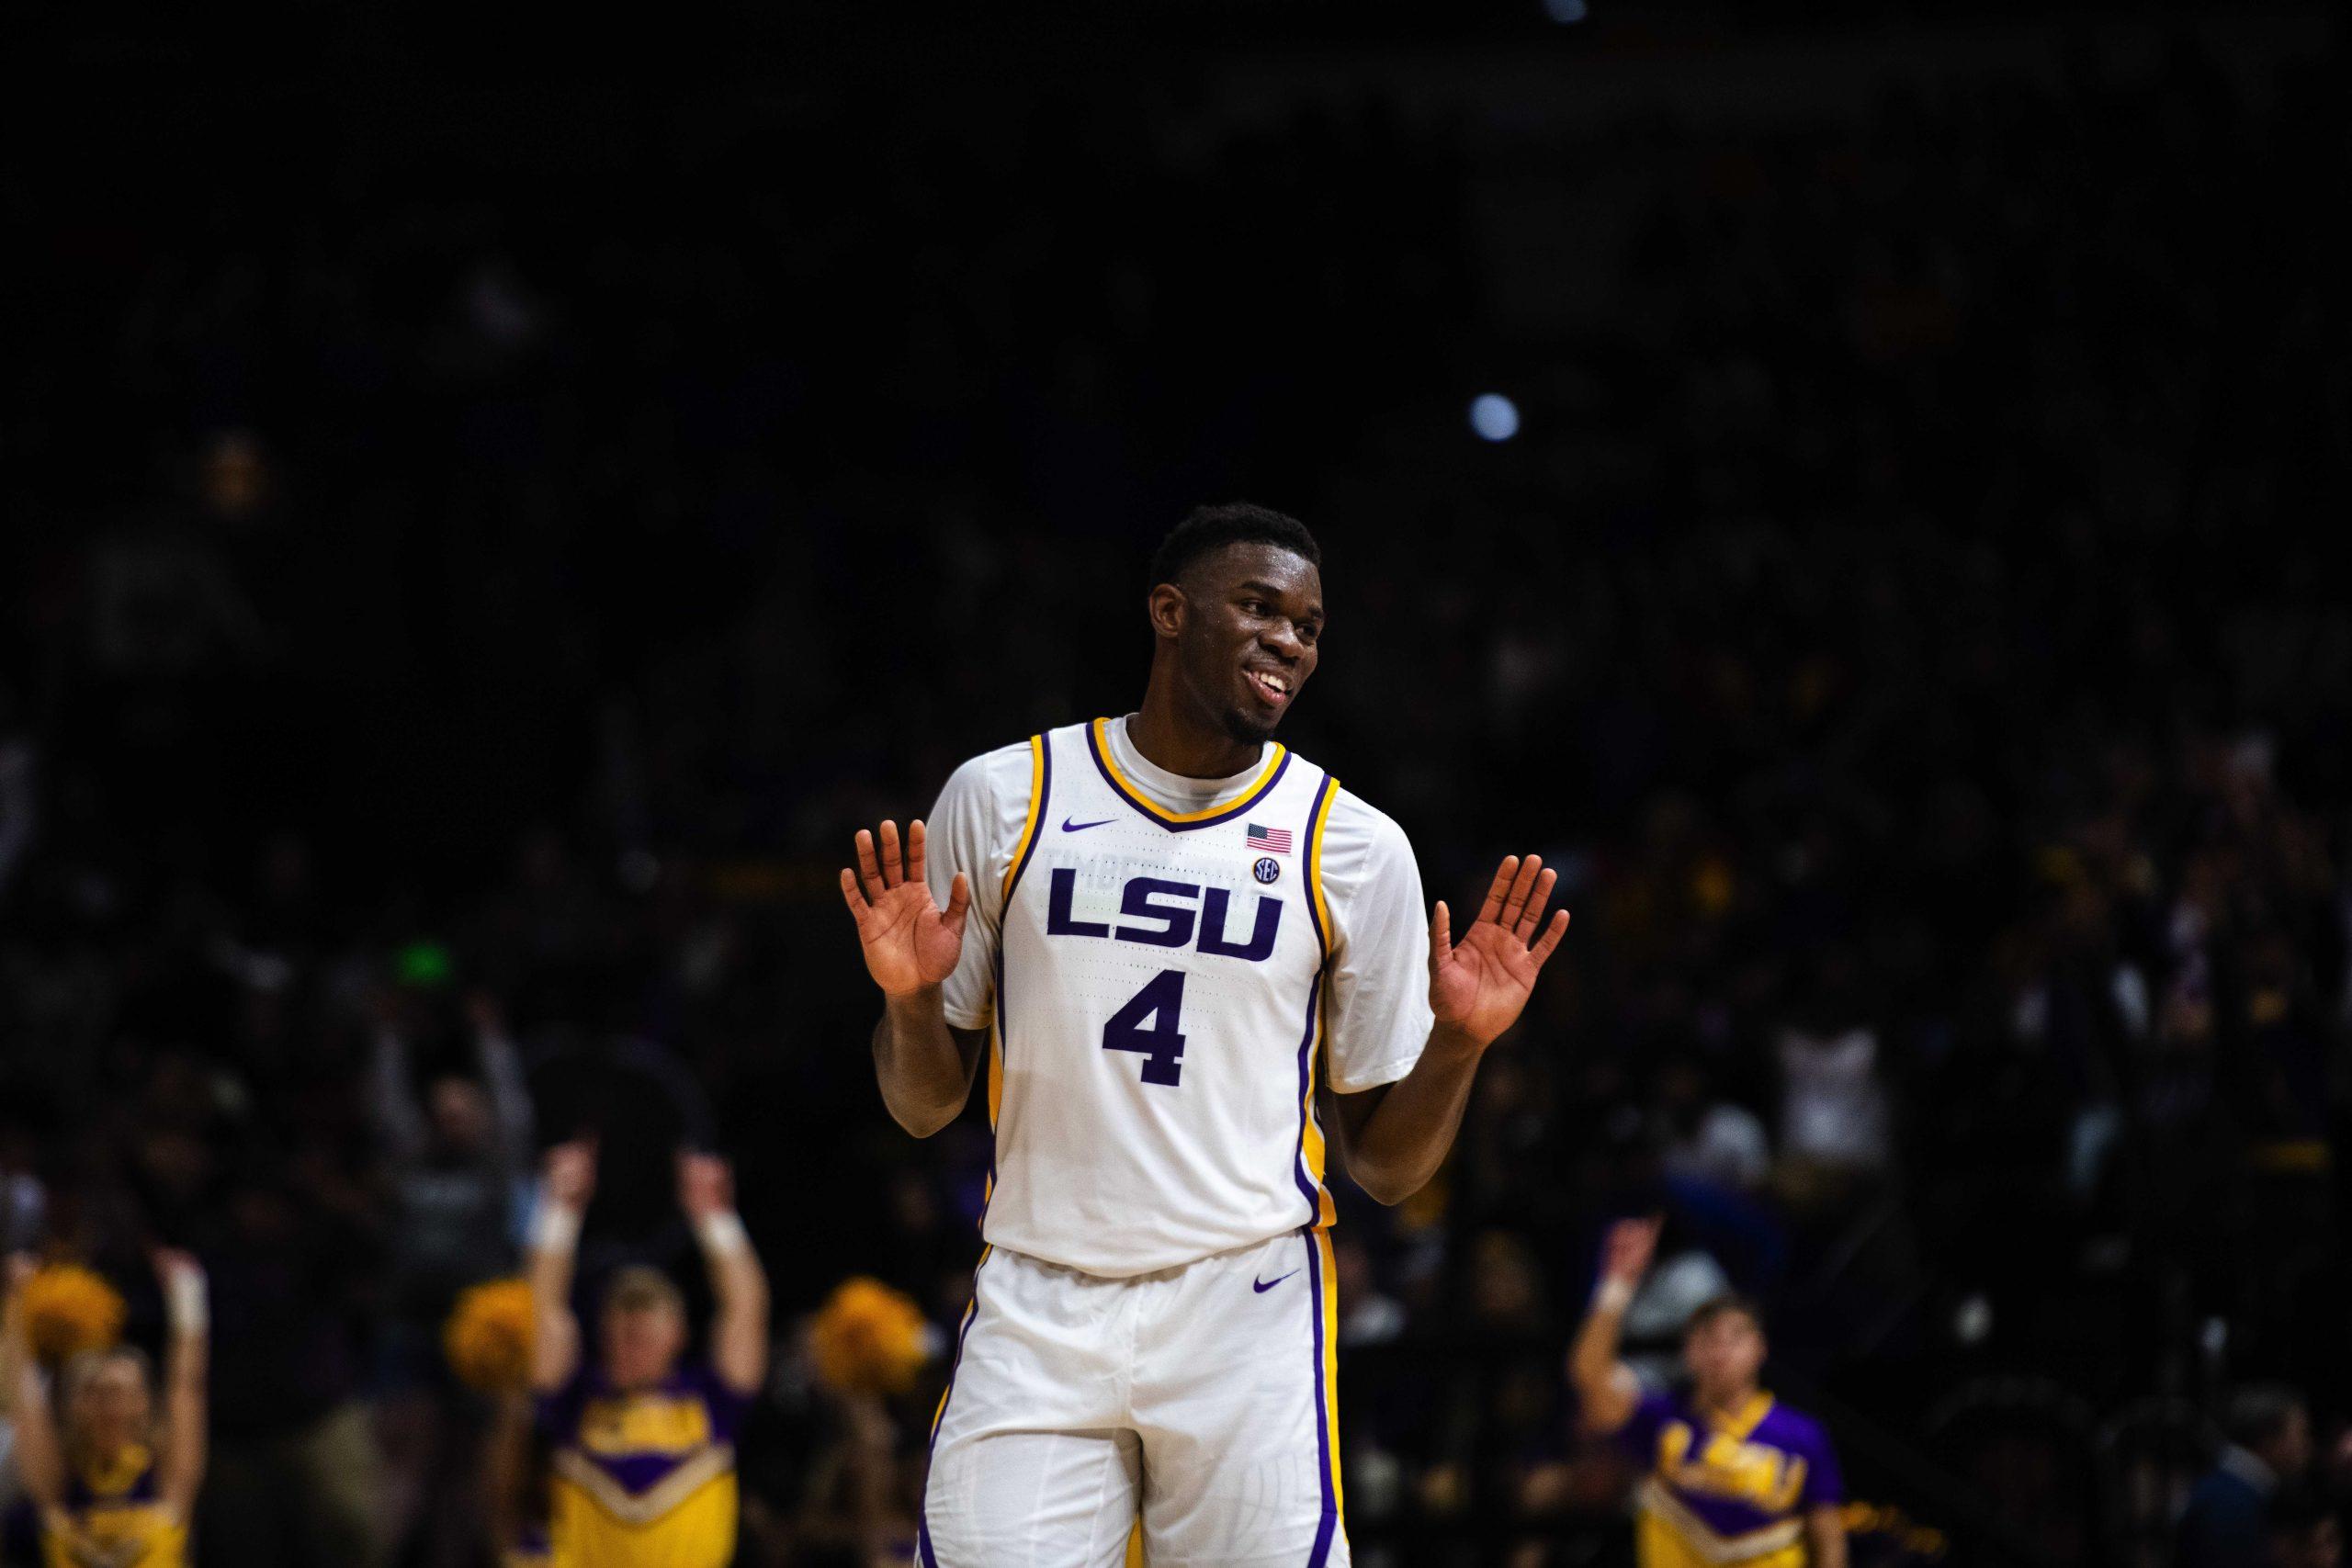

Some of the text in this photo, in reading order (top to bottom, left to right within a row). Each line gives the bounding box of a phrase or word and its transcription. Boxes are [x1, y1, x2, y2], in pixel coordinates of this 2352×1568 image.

[1047, 868, 1283, 962] LSU
[1255, 858, 1279, 882] SEC
[1102, 969, 1186, 1087] 4
